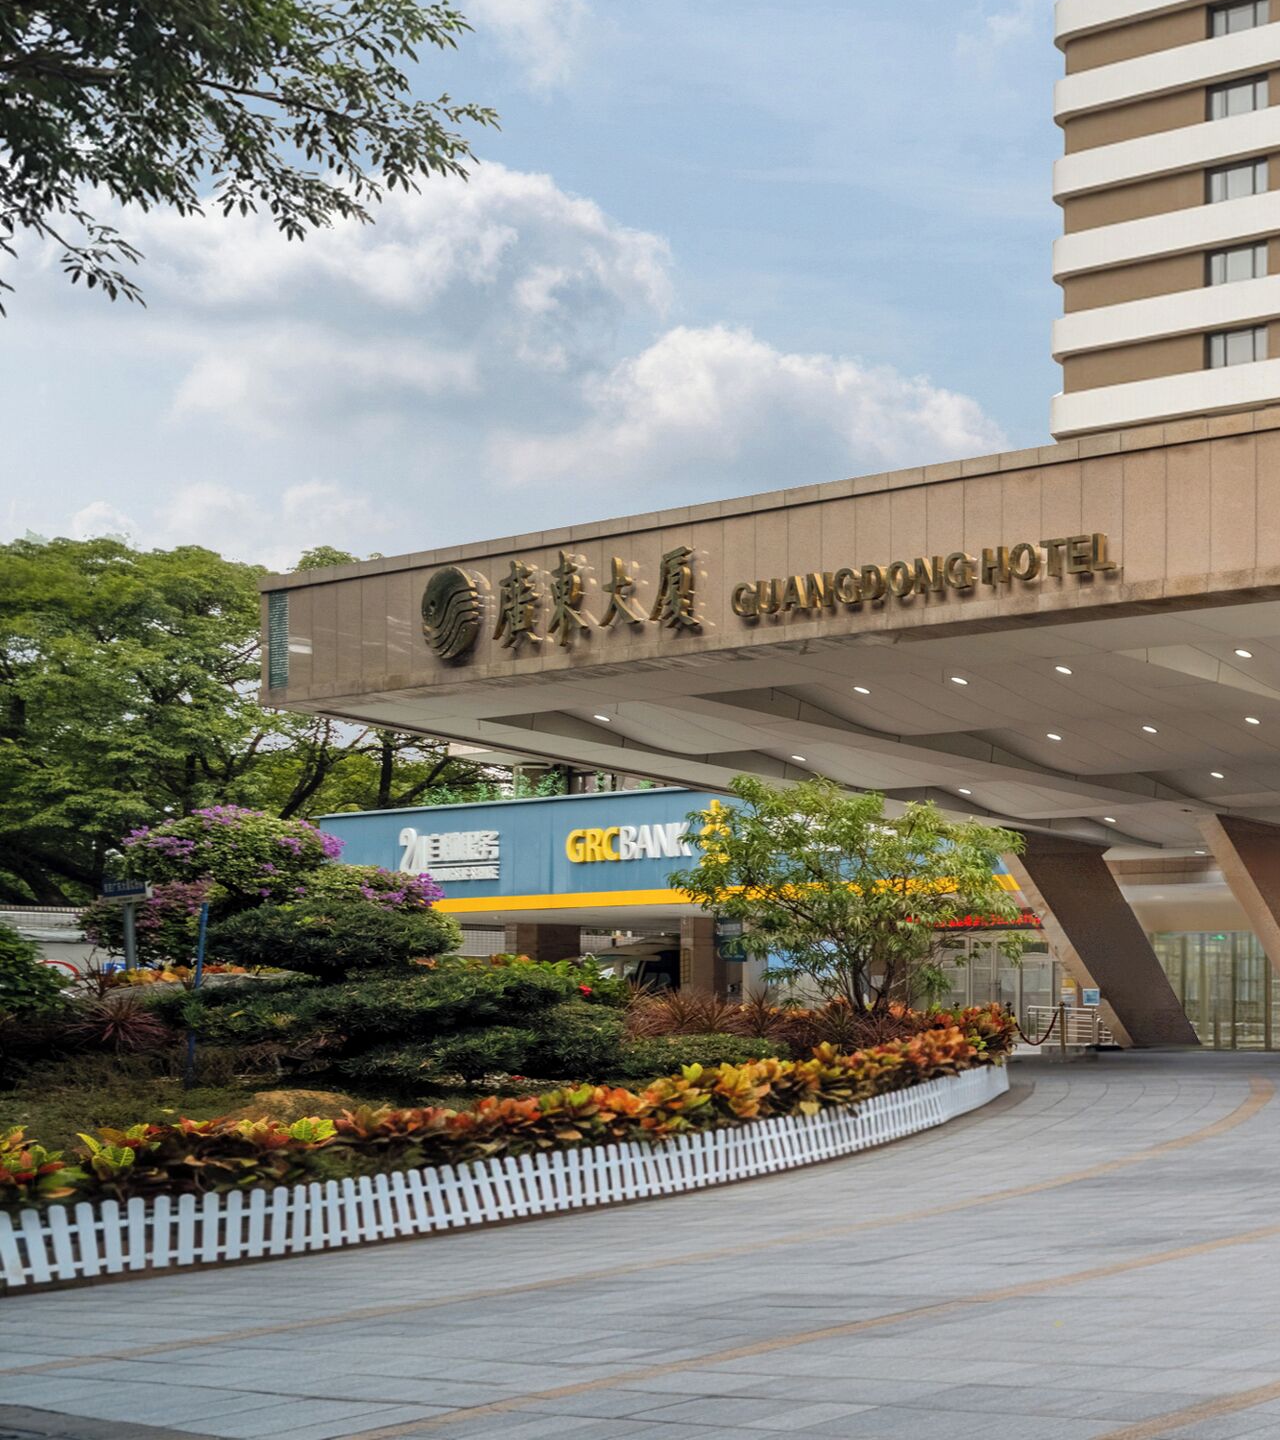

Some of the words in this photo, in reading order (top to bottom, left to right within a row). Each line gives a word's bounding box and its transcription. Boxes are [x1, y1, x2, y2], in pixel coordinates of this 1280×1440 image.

[731, 552, 978, 618] GUANGDONG
[981, 532, 1117, 587] HOTEL
[565, 821, 692, 864] GRCBANK
